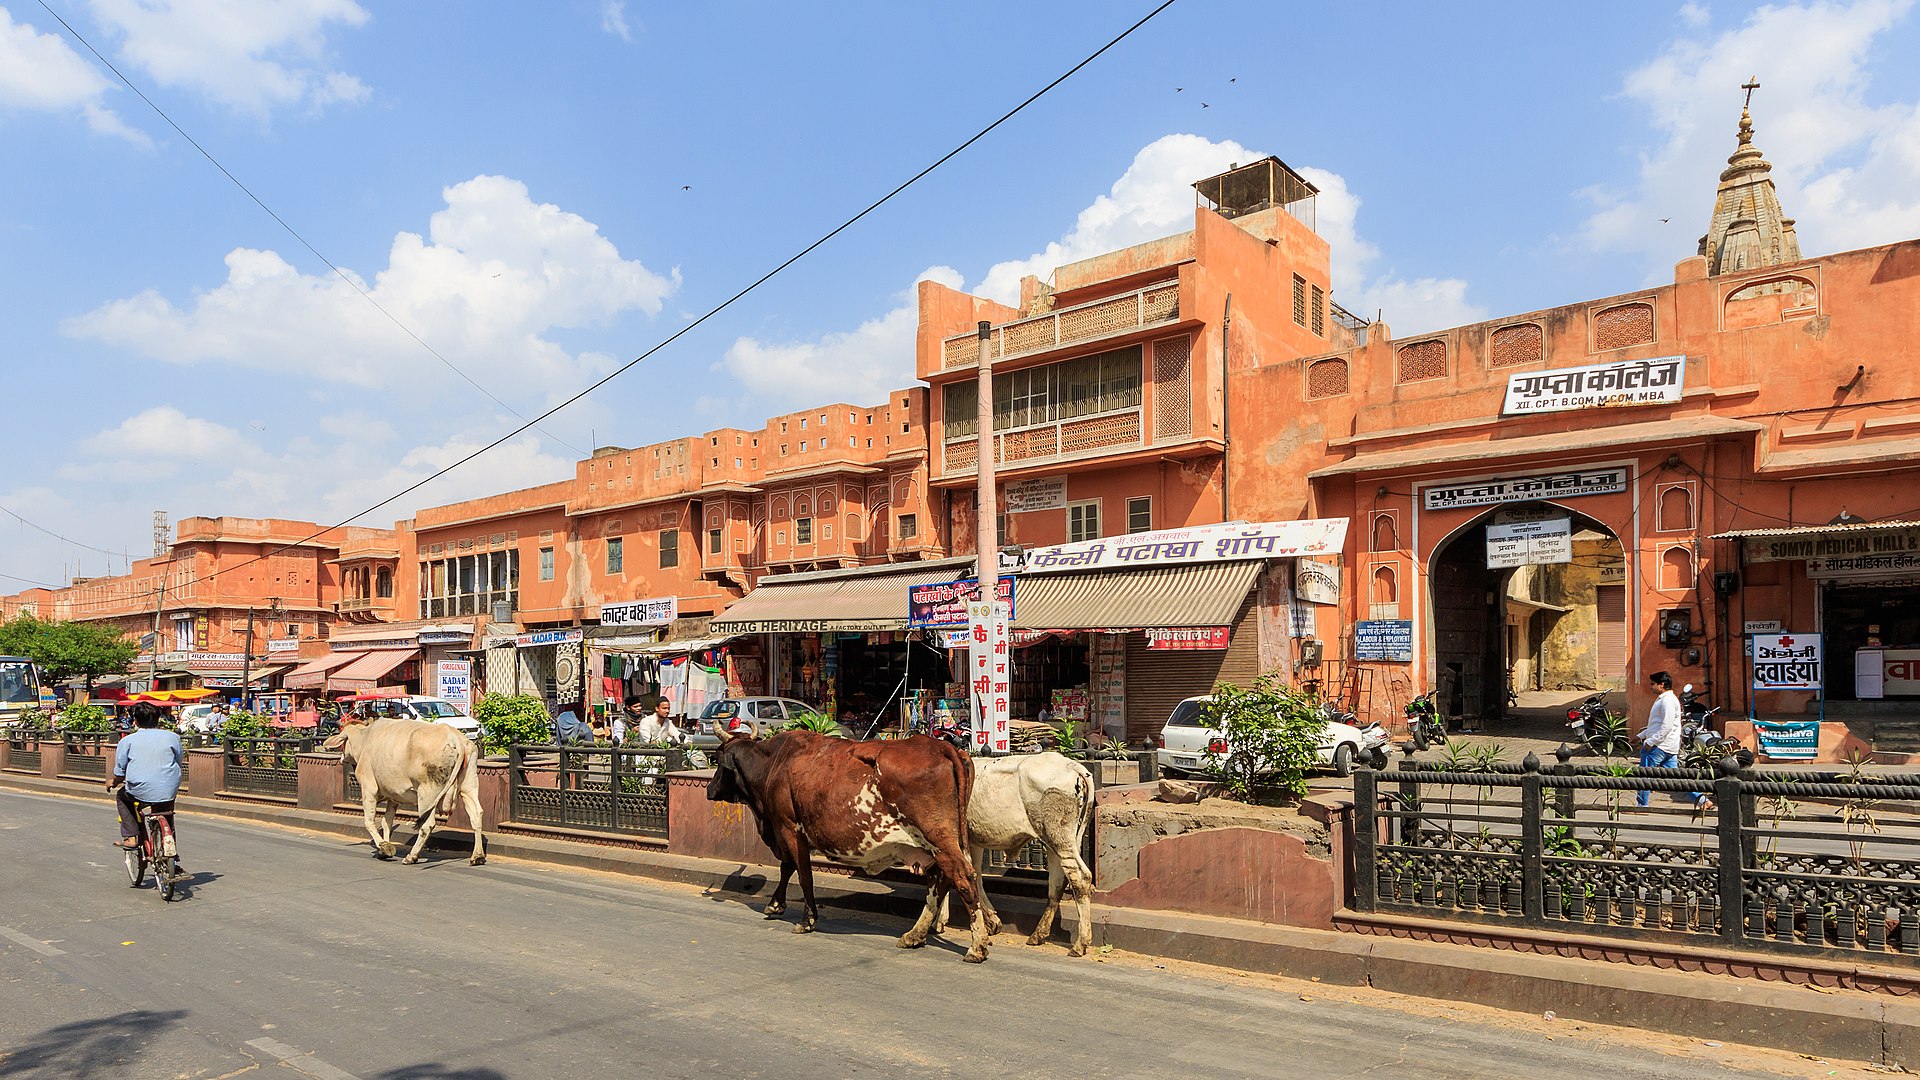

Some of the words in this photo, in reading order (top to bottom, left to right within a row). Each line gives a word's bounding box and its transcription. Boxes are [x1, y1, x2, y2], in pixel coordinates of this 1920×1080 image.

[1513, 372, 1587, 398] गुप्ता
[1587, 361, 1680, 392] कॉलेज
[1535, 399, 1559, 409] CPT.
[1561, 396, 1597, 407] B.COM.
[1598, 393, 1636, 406] M.COM.
[1639, 391, 1665, 401] MBA
[1430, 484, 1507, 501] गुप्ता
[1513, 472, 1620, 492] कॉलेज
[1546, 484, 1618, 496] 9829064030
[1034, 544, 1107, 567] फैन्सी
[1116, 540, 1204, 561] पटाखा
[1215, 530, 1281, 557] शॉप
[1770, 541, 1814, 557] SOMYA
[1816, 537, 1871, 556] MEDICAL
[1873, 535, 1904, 552] HALL
[1907, 536, 1918, 549] &
[913, 586, 943, 604] पटाखों
[943, 586, 954, 601] के
[602, 606, 628, 624] कादर
[664, 610, 672, 619] 27
[709, 622, 757, 633] CHIRAG
[761, 620, 828, 632] HERITAGE
[532, 632, 553, 645] KADAR
[554, 631, 567, 642] BUX
[1360, 635, 1378, 643] LABOUR
[441, 663, 467, 671] ORIGINAL
[442, 676, 466, 685] KADAR
[447, 686, 461, 694] BUX
